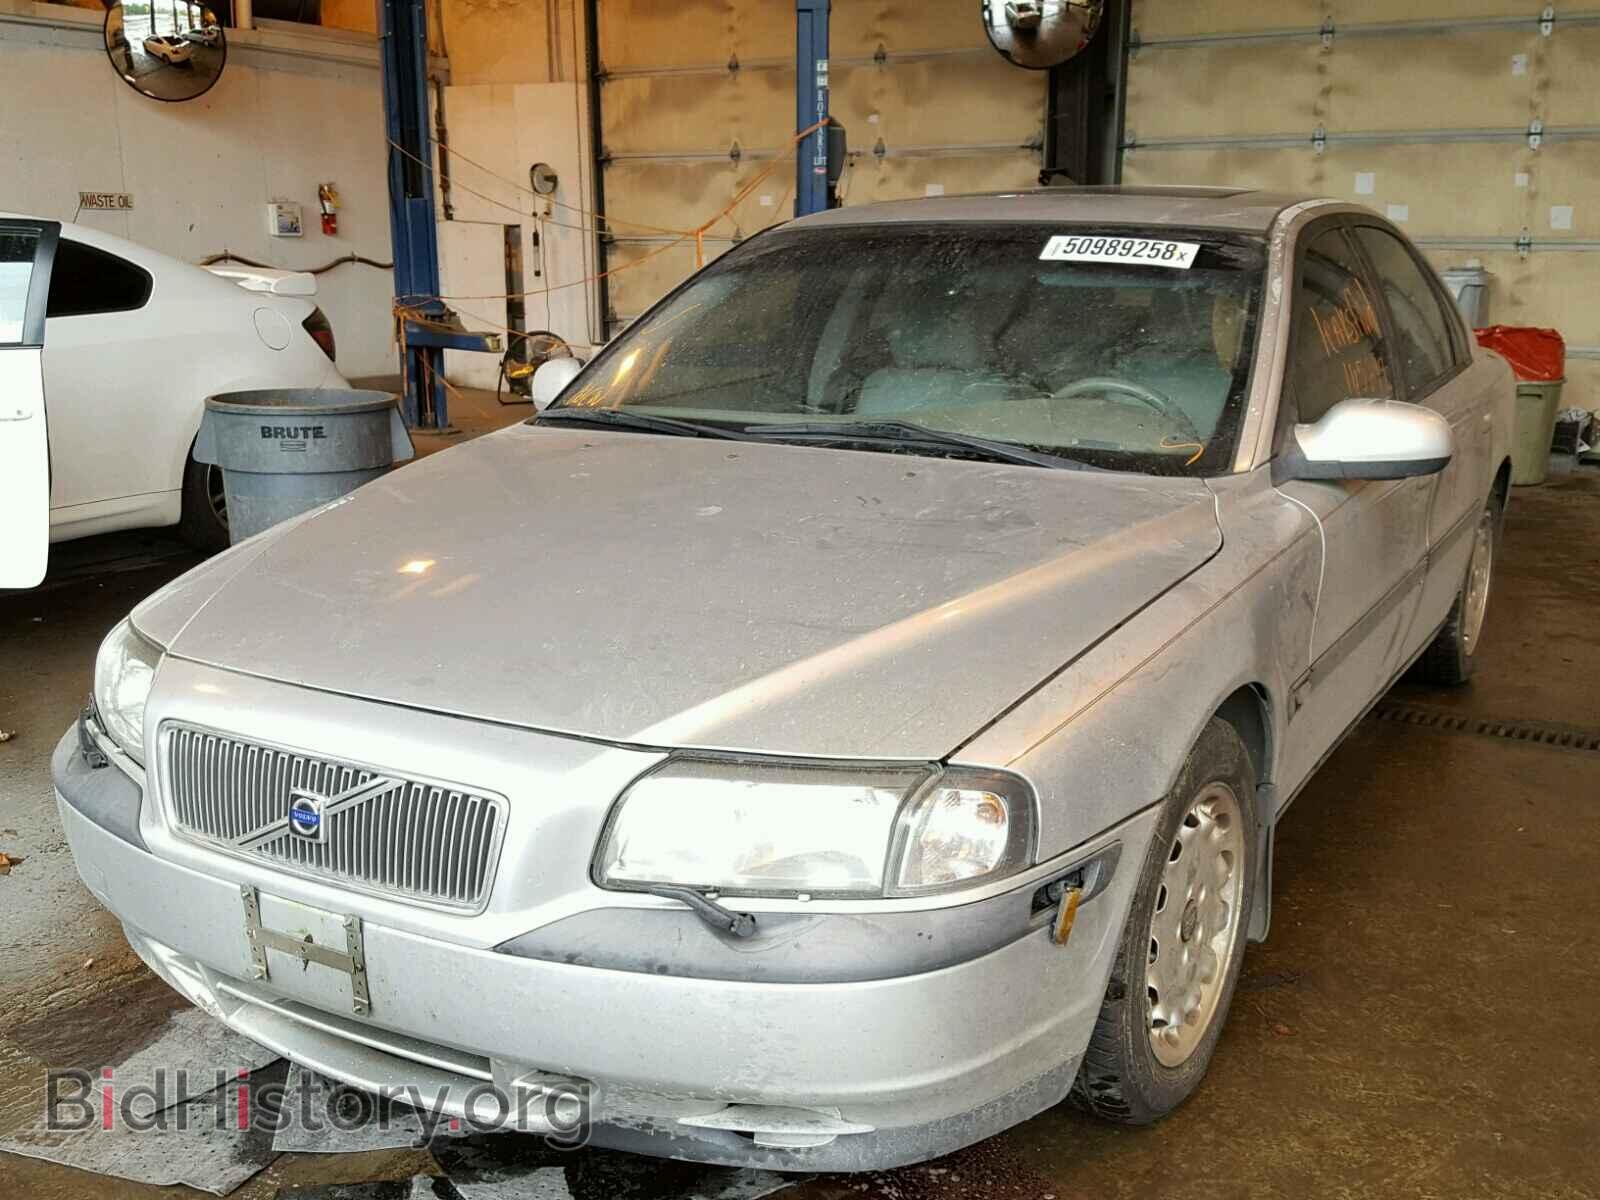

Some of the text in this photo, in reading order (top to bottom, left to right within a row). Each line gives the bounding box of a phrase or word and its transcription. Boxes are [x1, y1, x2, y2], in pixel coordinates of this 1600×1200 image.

[80, 194, 115, 208] WASTE
[261, 426, 328, 439] BRUTE
[294, 810, 318, 823] VOLVO
